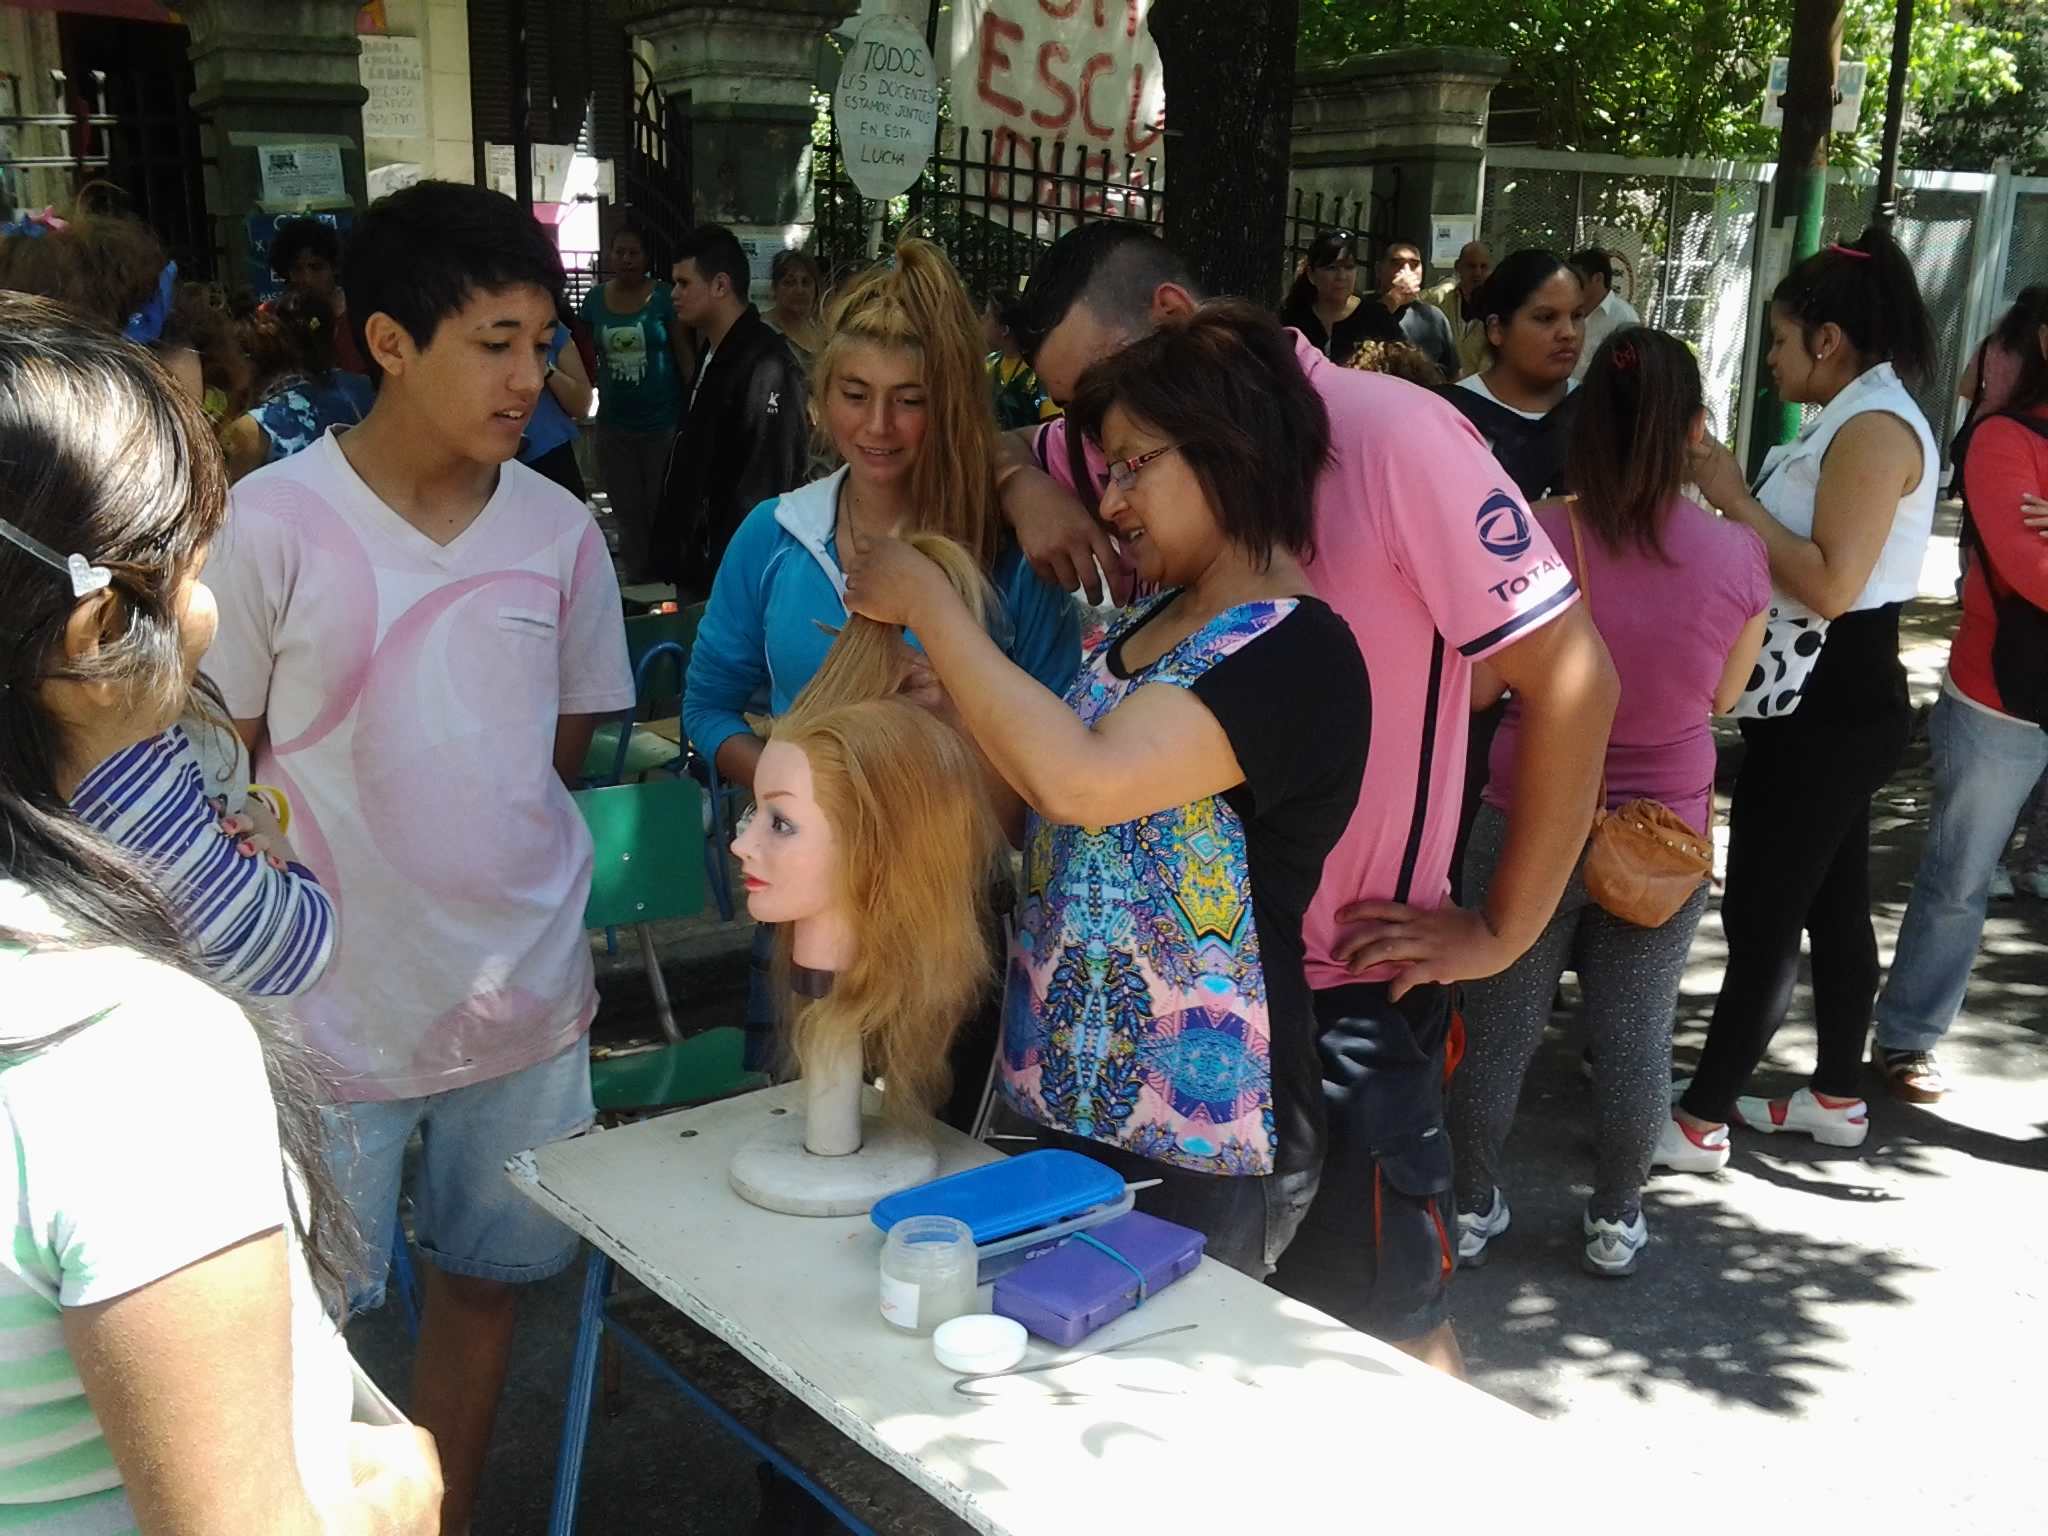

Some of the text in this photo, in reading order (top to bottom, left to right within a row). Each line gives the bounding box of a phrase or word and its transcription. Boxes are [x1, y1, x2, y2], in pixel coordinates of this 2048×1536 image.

[864, 41, 925, 77] TODOS
[878, 78, 935, 104] DOCENTES
[860, 121, 912, 139] EN ESTA
[860, 143, 905, 166] LUCHA
[1488, 555, 1562, 602] TOTAL
